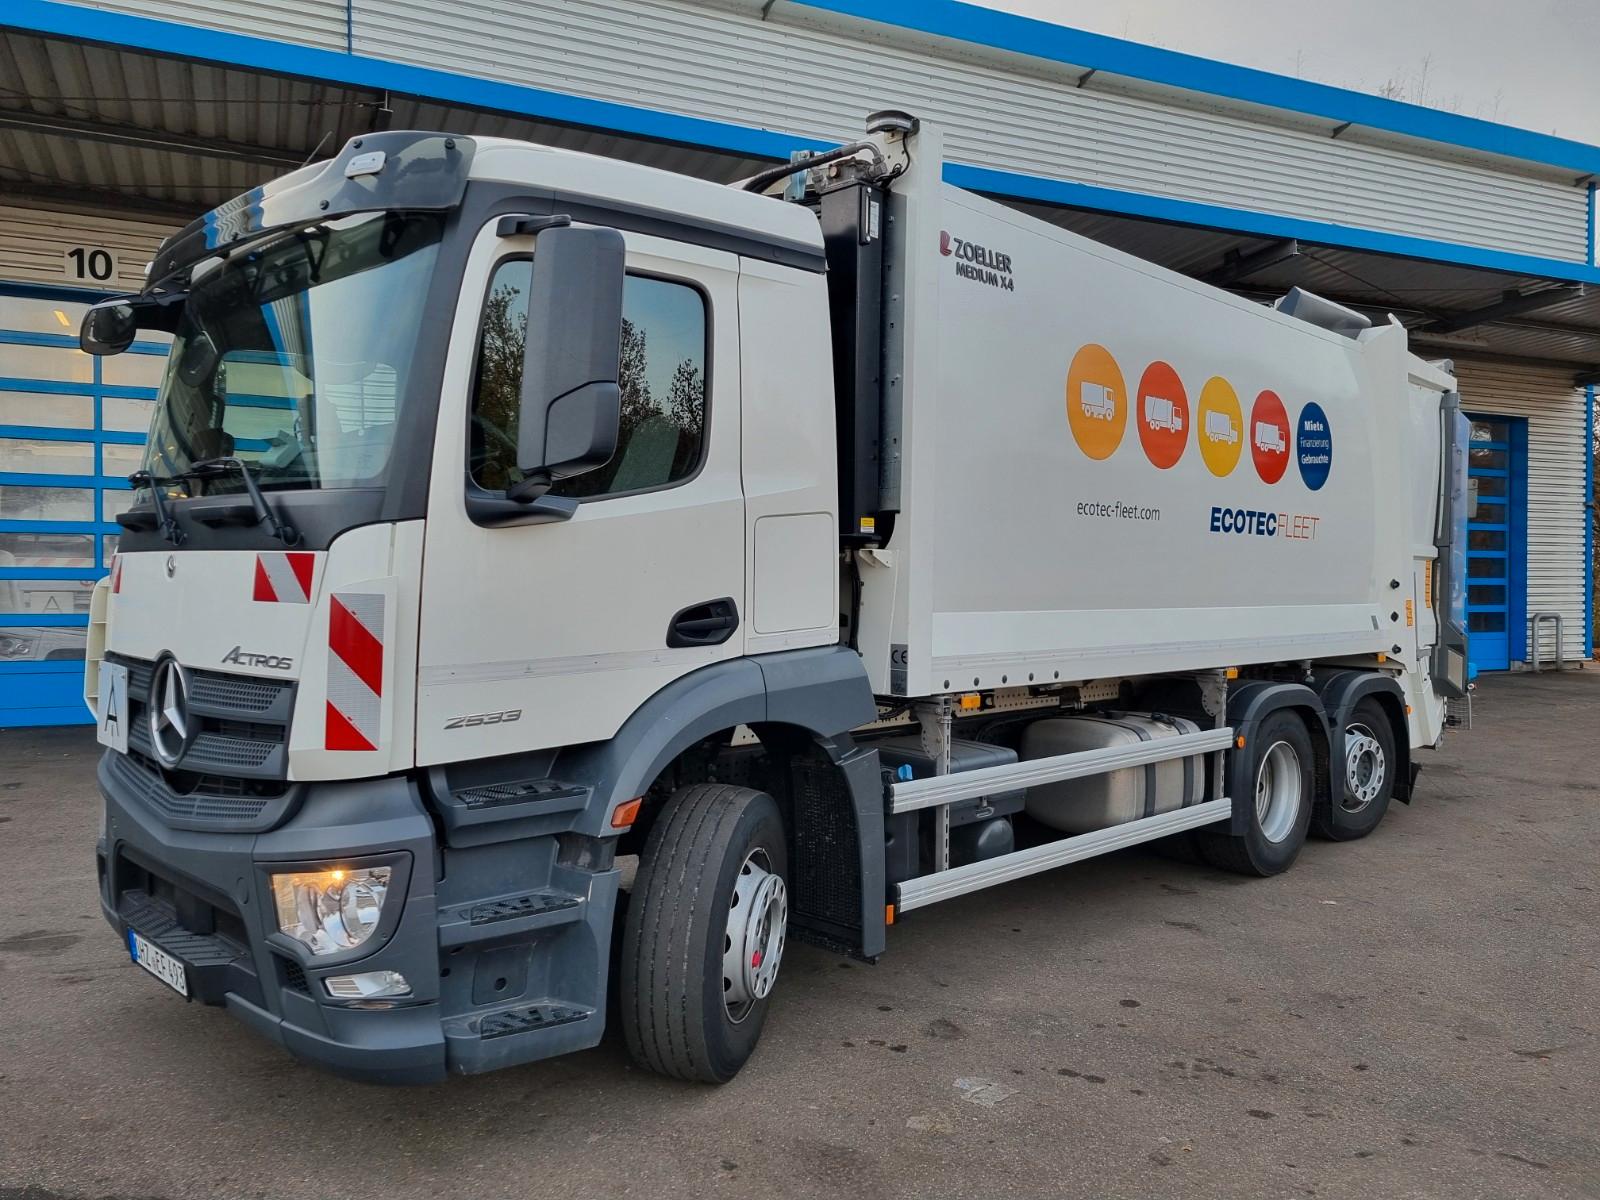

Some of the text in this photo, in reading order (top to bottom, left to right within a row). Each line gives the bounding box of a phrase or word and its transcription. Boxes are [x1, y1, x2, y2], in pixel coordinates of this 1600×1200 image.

[68, 248, 112, 280] 10
[953, 237, 1012, 274] ZOELLER
[956, 262, 1014, 292] MEDIUM X4
[1304, 420, 1324, 432] Miete
[1301, 453, 1329, 465] Gebrauchte
[1077, 500, 1160, 521] ecotec-fleet.com
[1210, 506, 1320, 540] ECOTECFLEET
[104, 674, 119, 736] A
[443, 709, 522, 730] 2533
